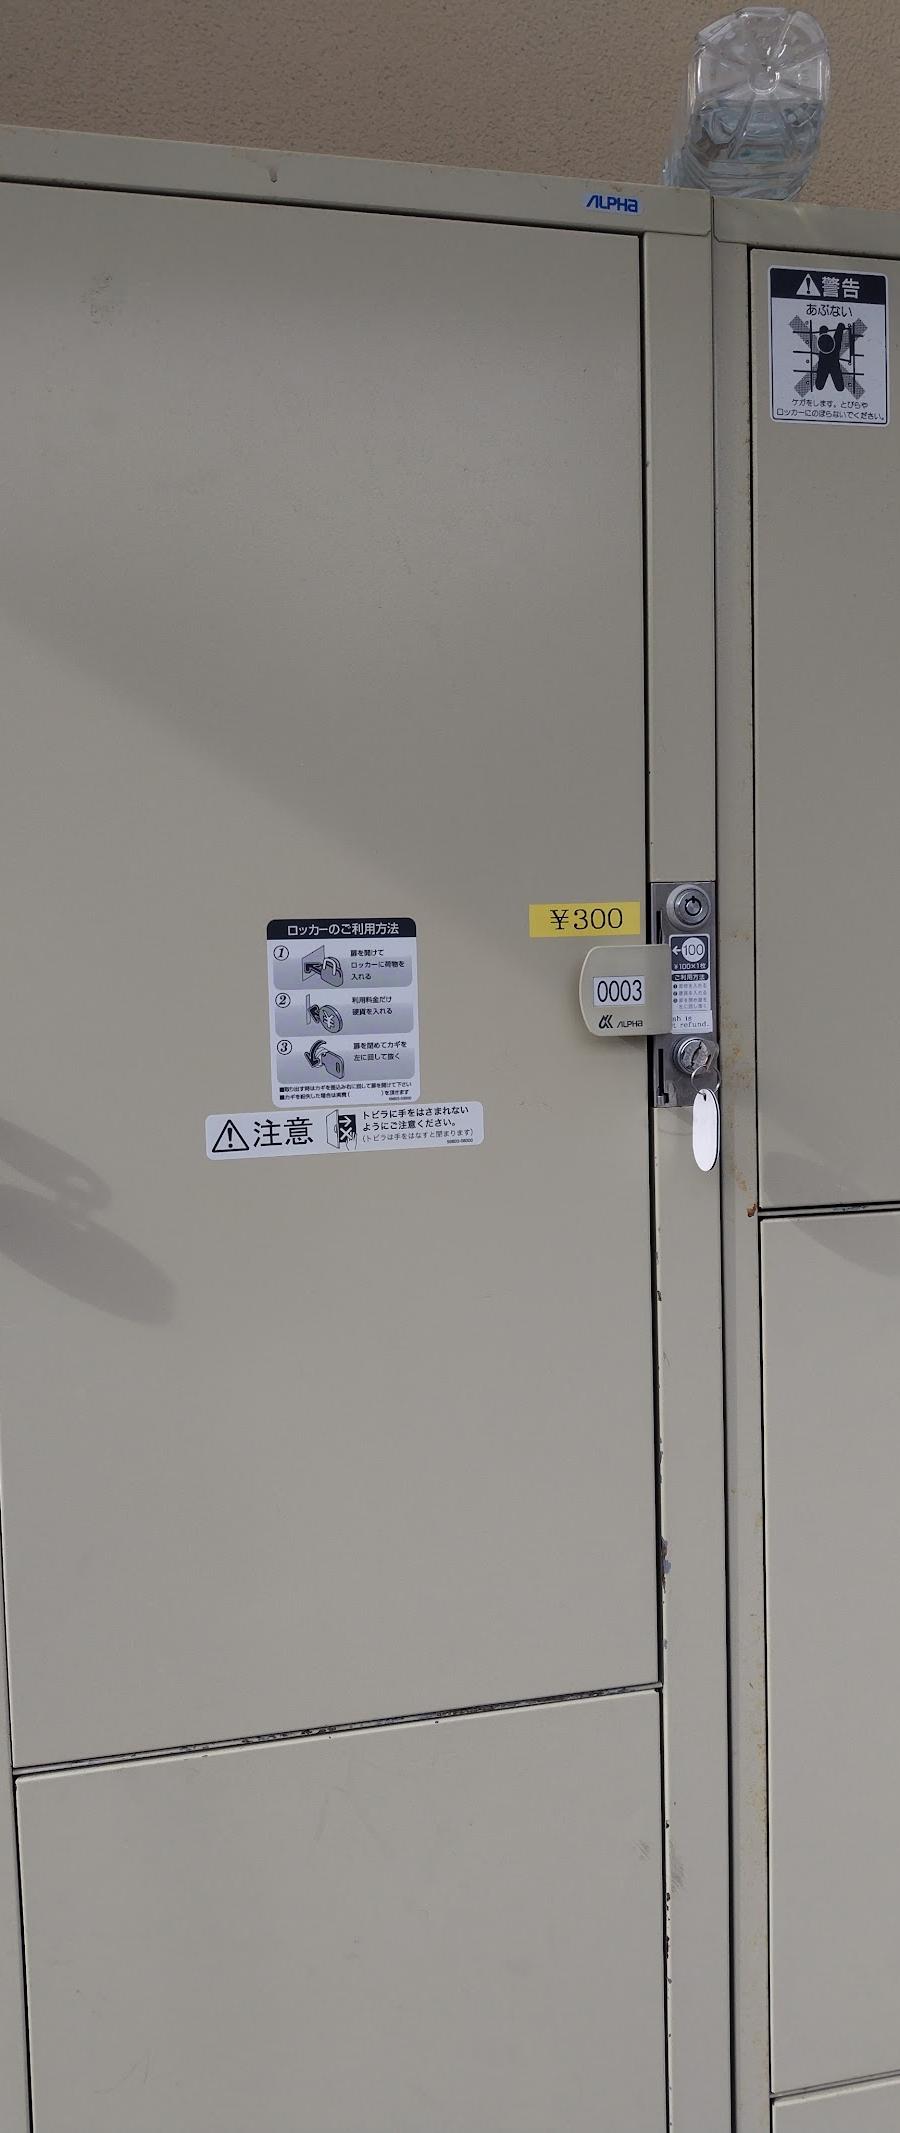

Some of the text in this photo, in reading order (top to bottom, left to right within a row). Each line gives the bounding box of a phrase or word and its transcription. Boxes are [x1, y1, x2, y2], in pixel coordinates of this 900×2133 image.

[821, 276, 860, 299] 警告
[806, 303, 853, 318] あぶない
[776, 408, 885, 421] ロッカーにのぼらないでください。
[549, 907, 623, 930] ¥300
[287, 922, 400, 936] ロッカーのご利用方法
[350, 949, 385, 957] 扉を開けて
[682, 943, 703, 956] 100
[351, 960, 405, 969] ロッカーに荷物を
[351, 973, 372, 981] 入れる
[597, 979, 642, 1003] 0003
[351, 995, 392, 1004] 利用料金だけ
[352, 1007, 393, 1016] 硬貨を入れる
[353, 1041, 407, 1049] 扉を閉めてカギを
[353, 1053, 400, 1062] 左に回して抜く
[363, 1106, 469, 1119] トビラに手をはさまれない
[362, 1119, 456, 1131] ようにご注意ください。
[253, 1117, 314, 1147] 注意
